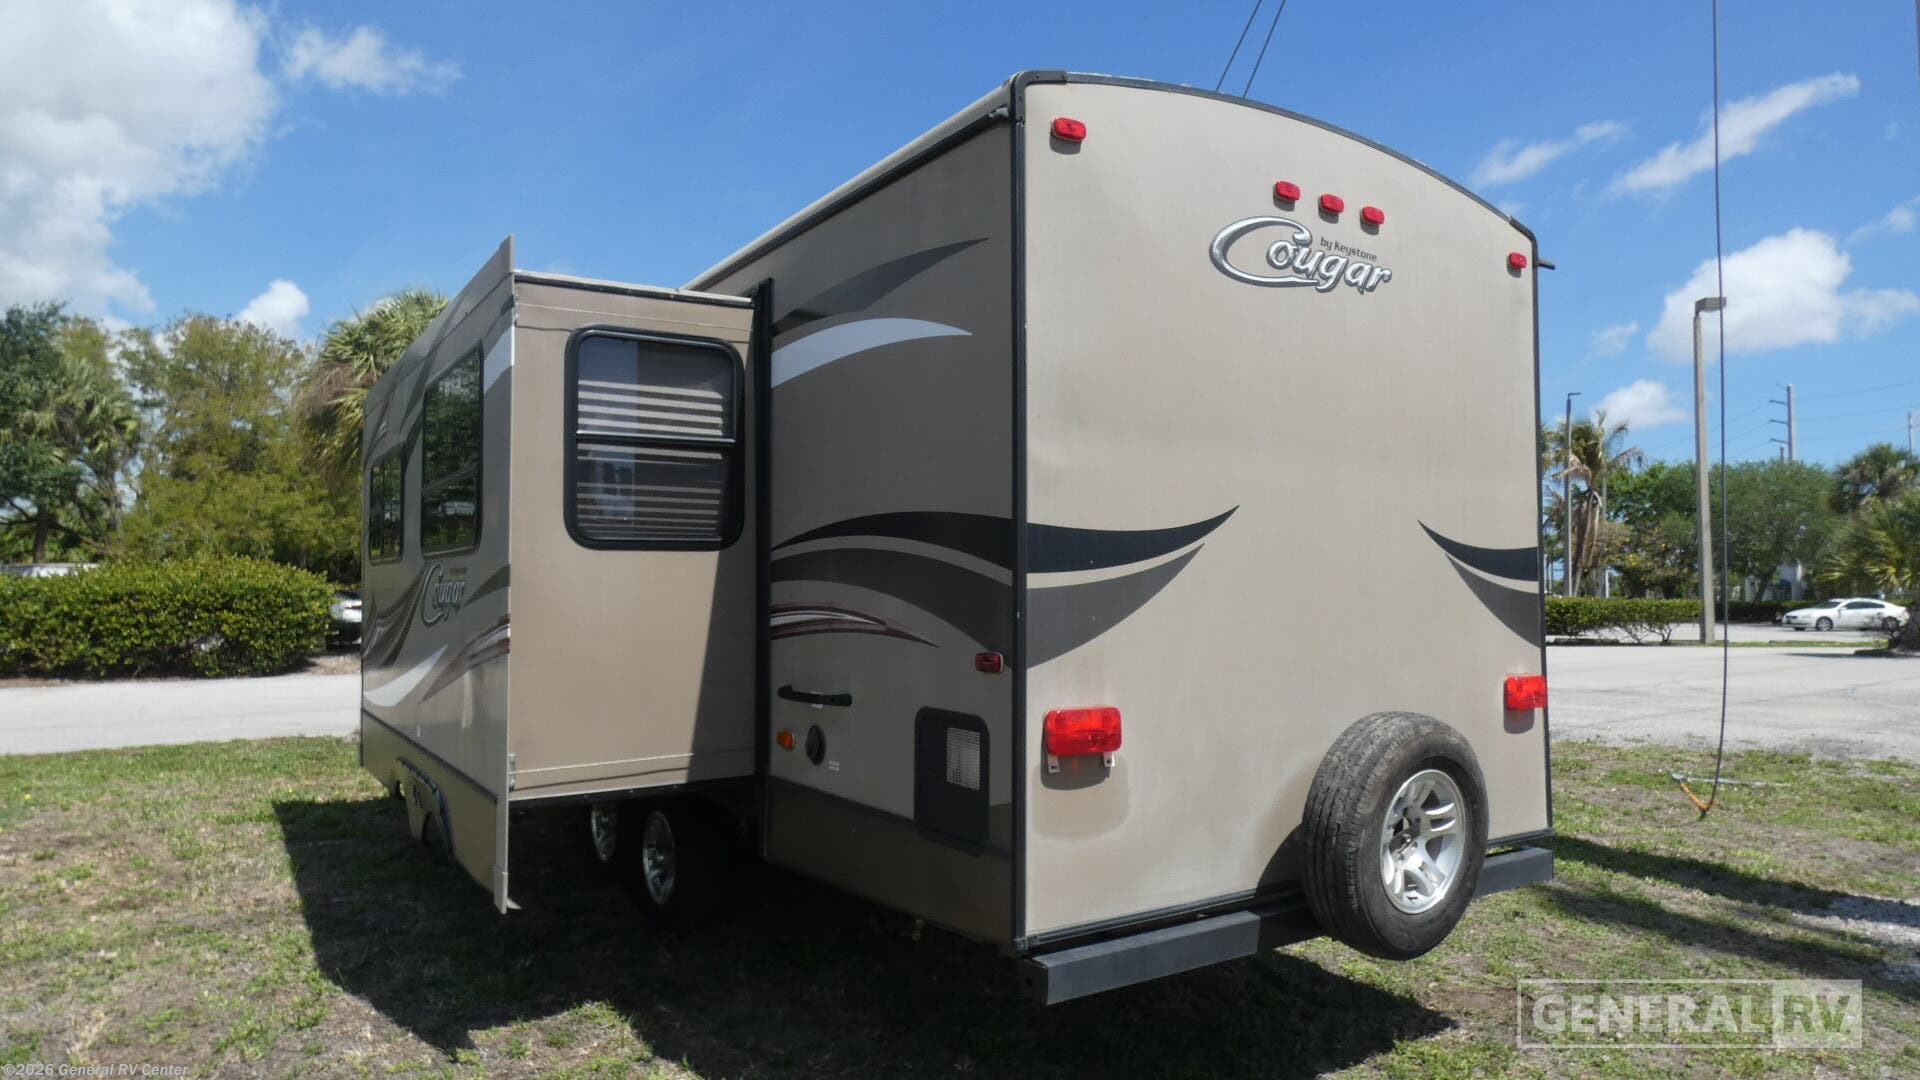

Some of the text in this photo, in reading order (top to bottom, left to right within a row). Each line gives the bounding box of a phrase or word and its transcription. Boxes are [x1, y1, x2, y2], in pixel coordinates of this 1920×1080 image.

[1209, 216, 1392, 295] Cougar
[1320, 236, 1377, 262] by Keystone
[422, 562, 465, 628] Cougar
